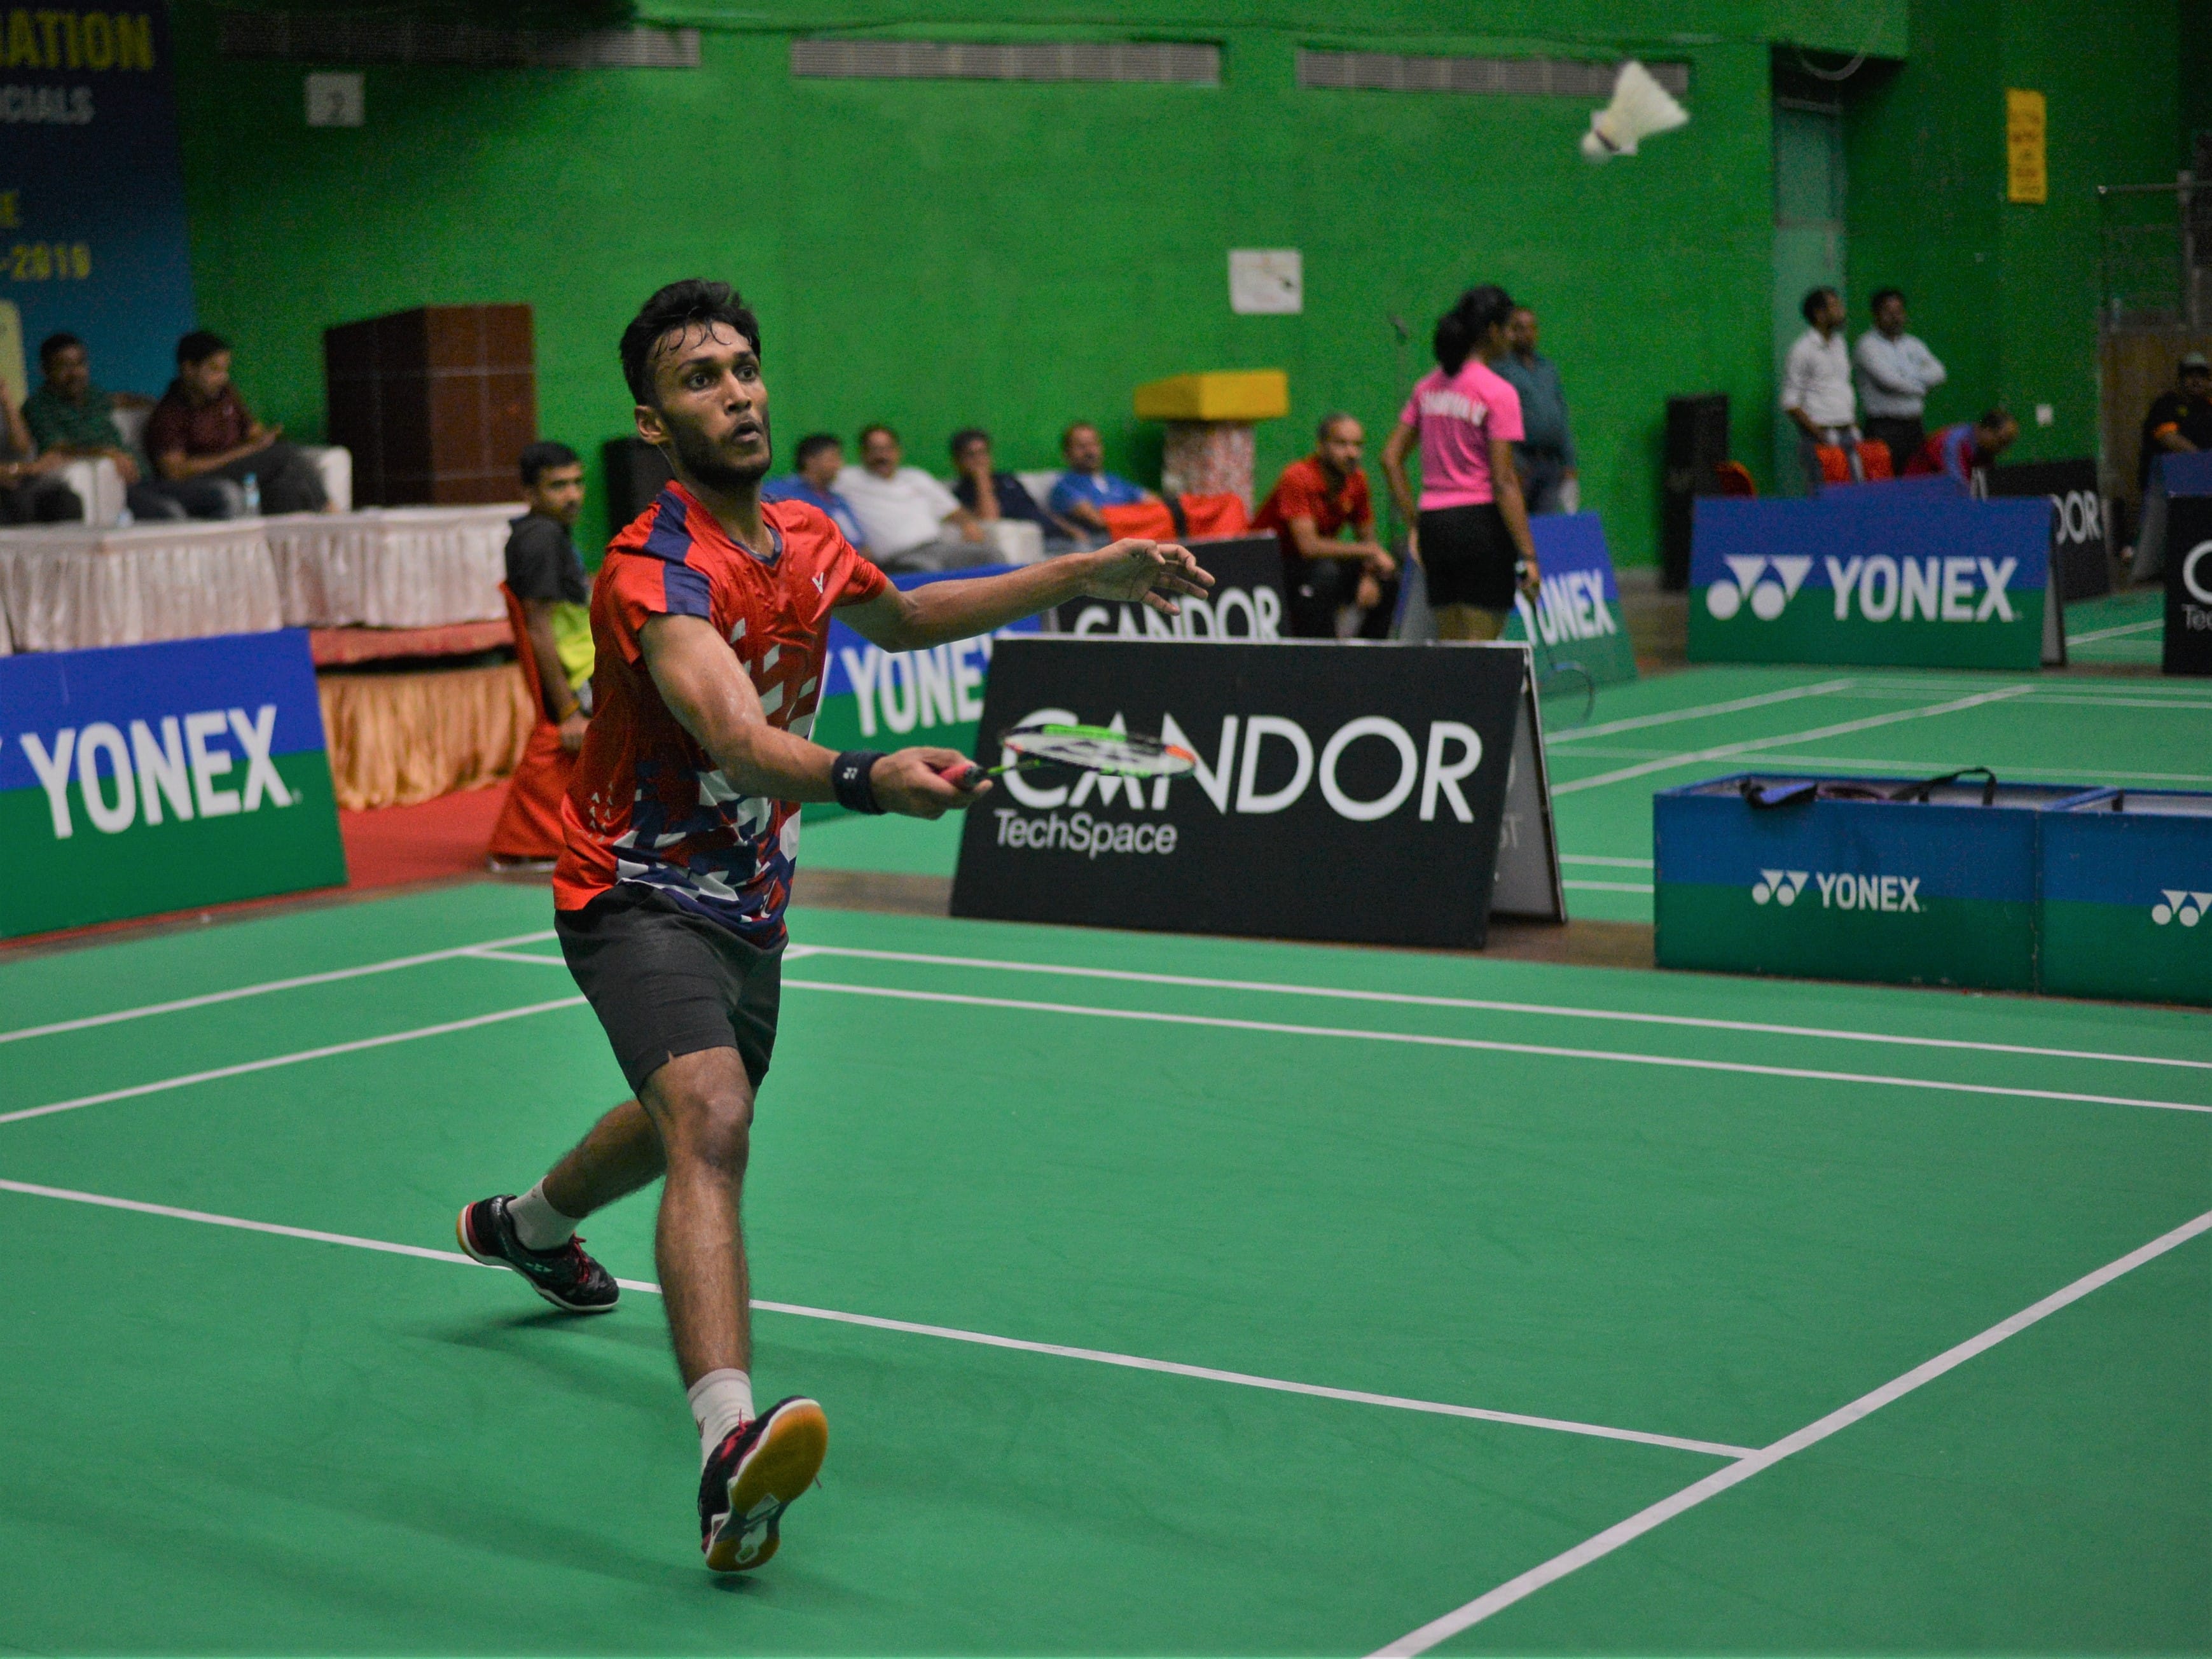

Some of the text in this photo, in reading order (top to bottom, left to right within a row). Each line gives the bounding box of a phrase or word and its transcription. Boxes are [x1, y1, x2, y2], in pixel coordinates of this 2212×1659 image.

[0, 9, 153, 71] ATION
[1824, 554, 2019, 622] YONEX
[19, 705, 294, 839] YONEX
[993, 808, 1178, 860] TechSpace
[1816, 871, 1920, 913] YONEX
